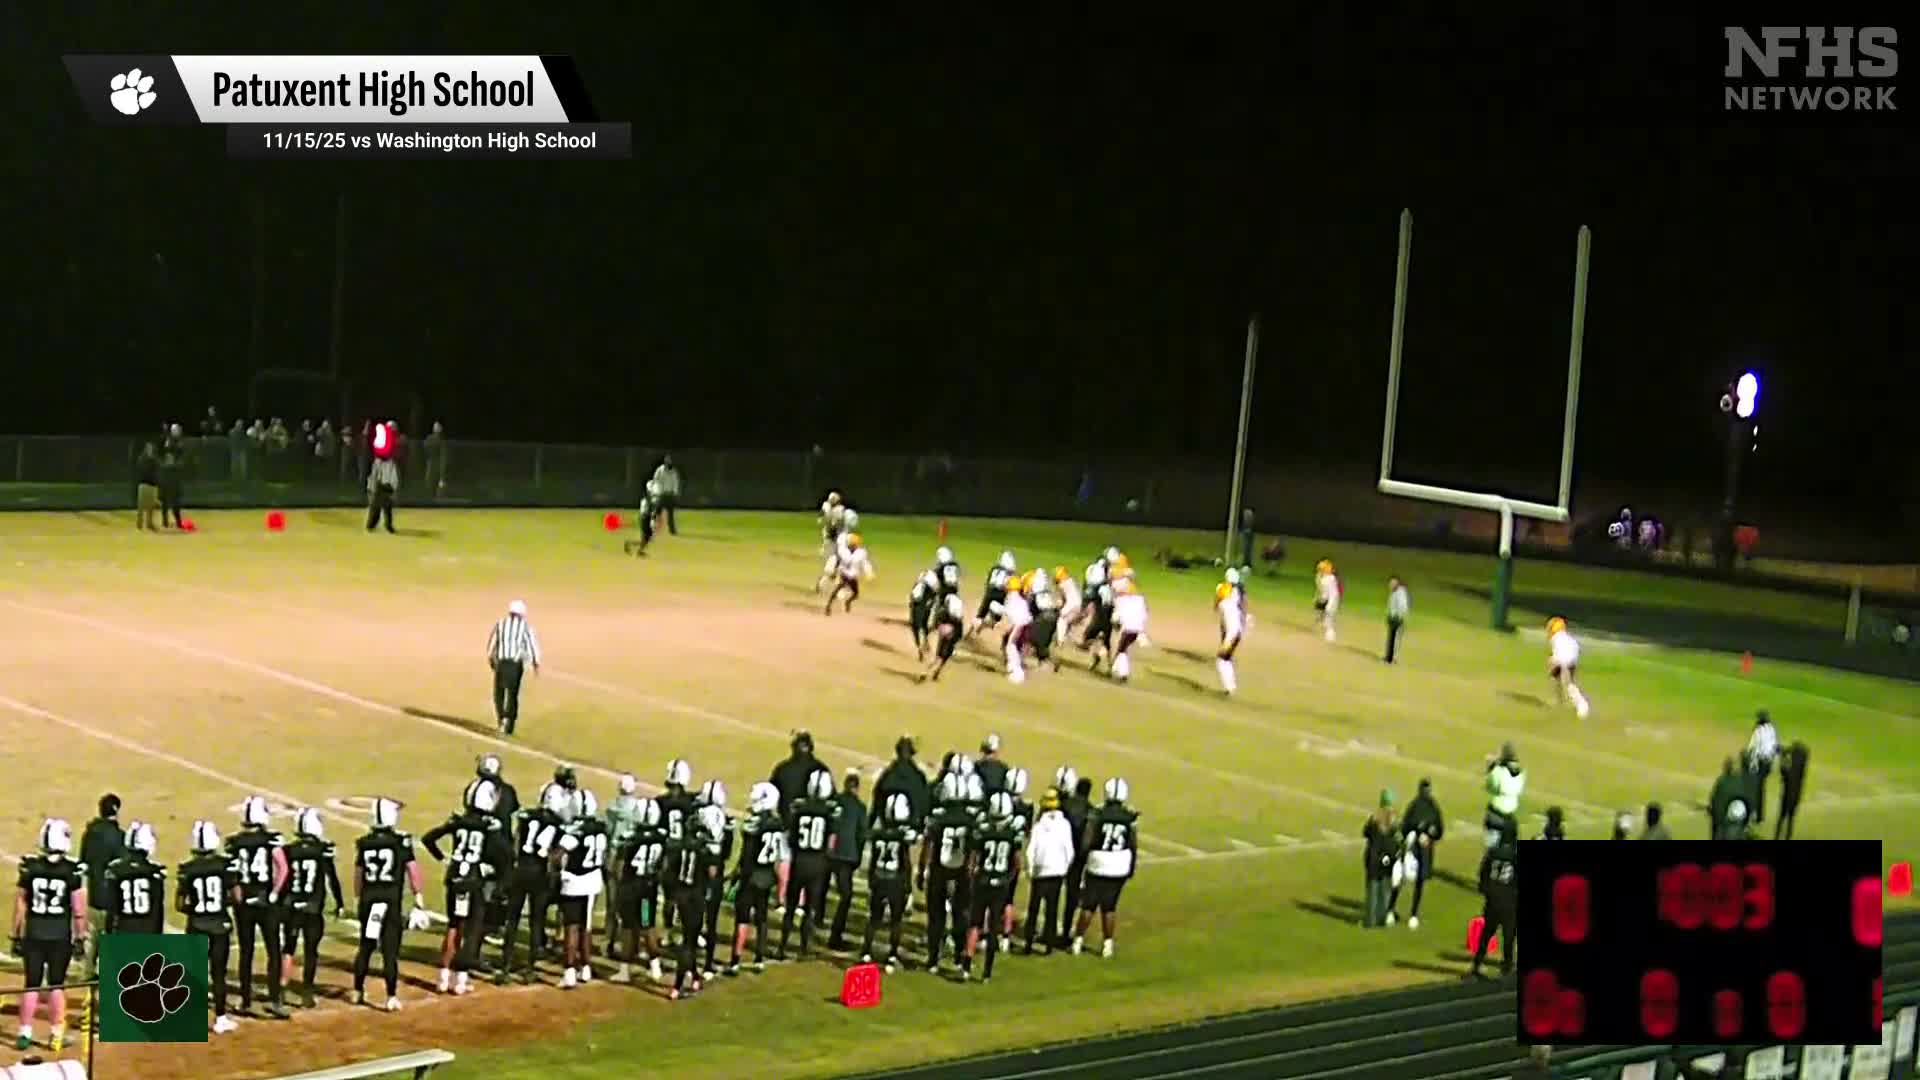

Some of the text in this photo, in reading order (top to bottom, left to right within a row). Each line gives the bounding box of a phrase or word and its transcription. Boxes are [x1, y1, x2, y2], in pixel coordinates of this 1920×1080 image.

[522, 820, 557, 858] 14
[799, 816, 825, 850] 50
[363, 848, 394, 882] 52
[119, 877, 150, 914] 16
[192, 875, 221, 913] 19
